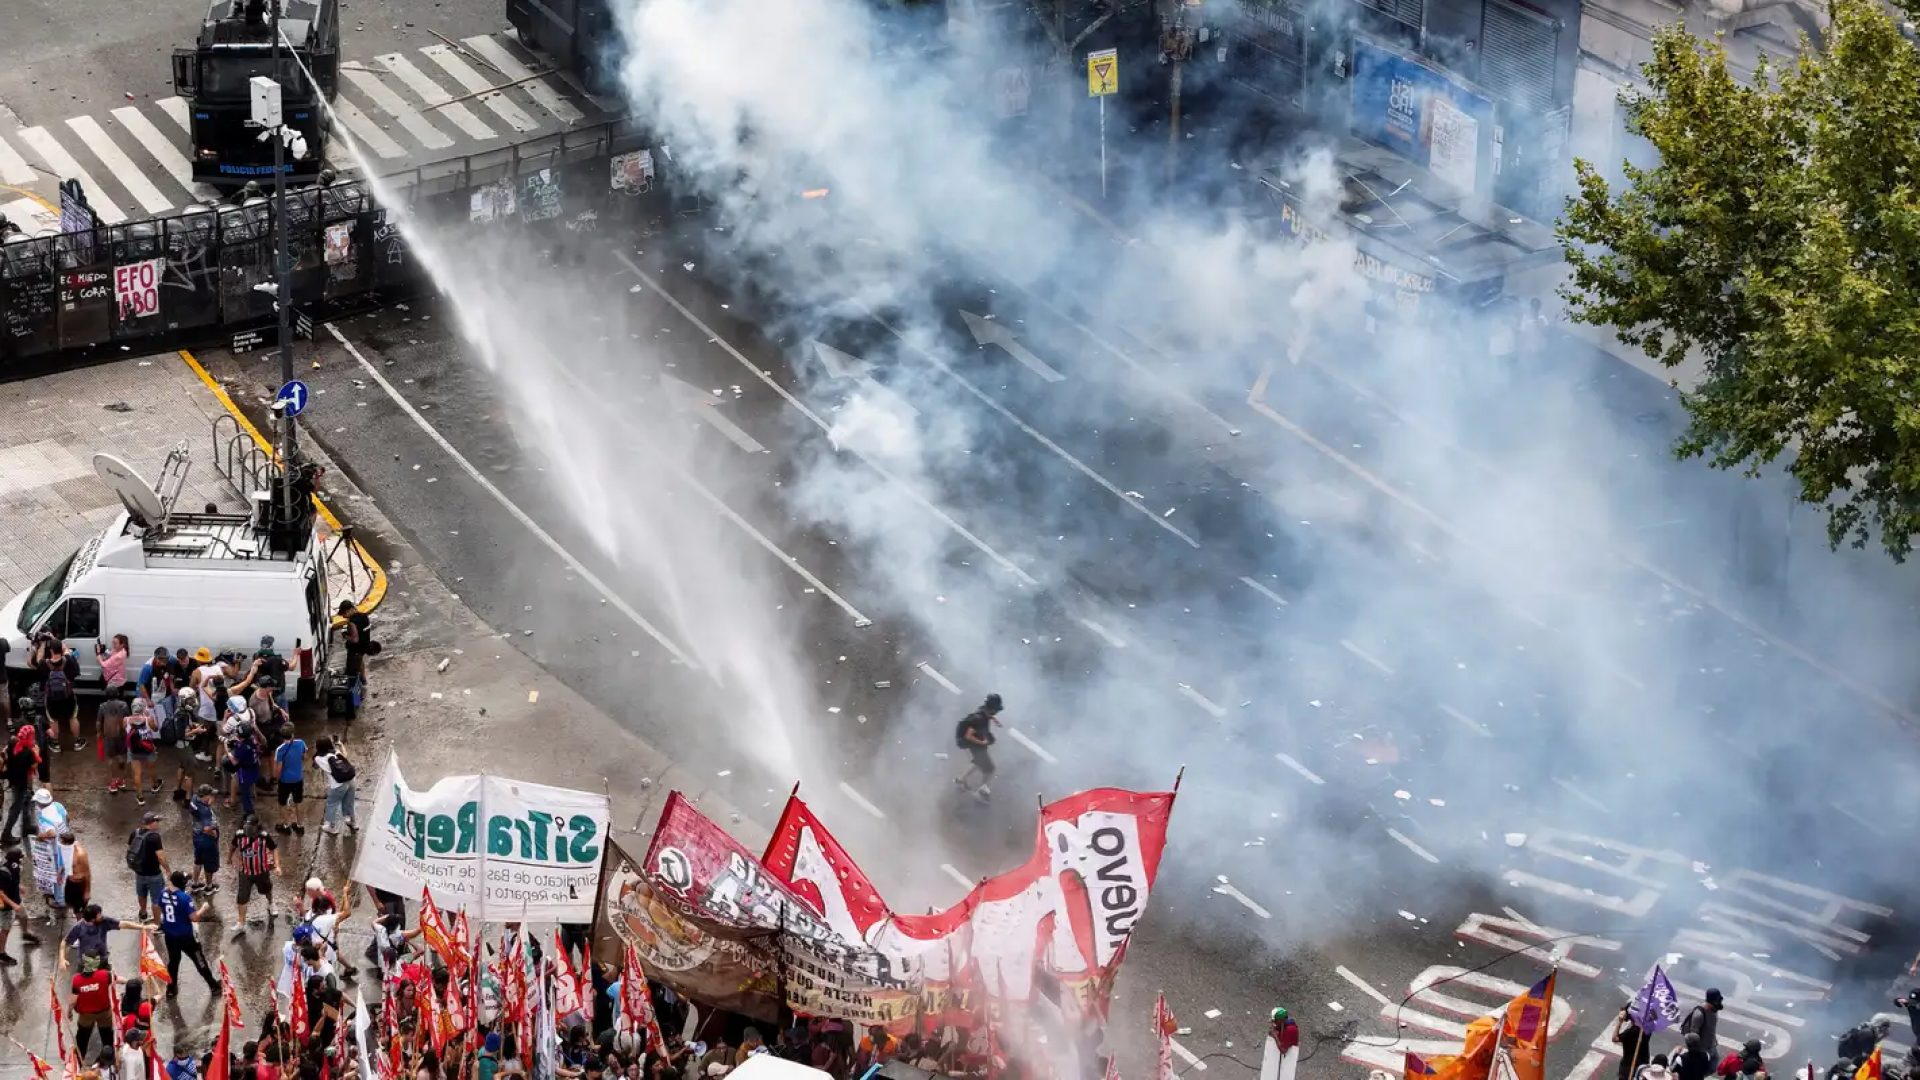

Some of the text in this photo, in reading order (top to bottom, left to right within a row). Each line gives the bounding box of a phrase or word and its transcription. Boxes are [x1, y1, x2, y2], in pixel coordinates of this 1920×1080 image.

[77, 272, 109, 284] MIEDO
[117, 263, 154, 293] EFO
[165, 904, 176, 923] 8
